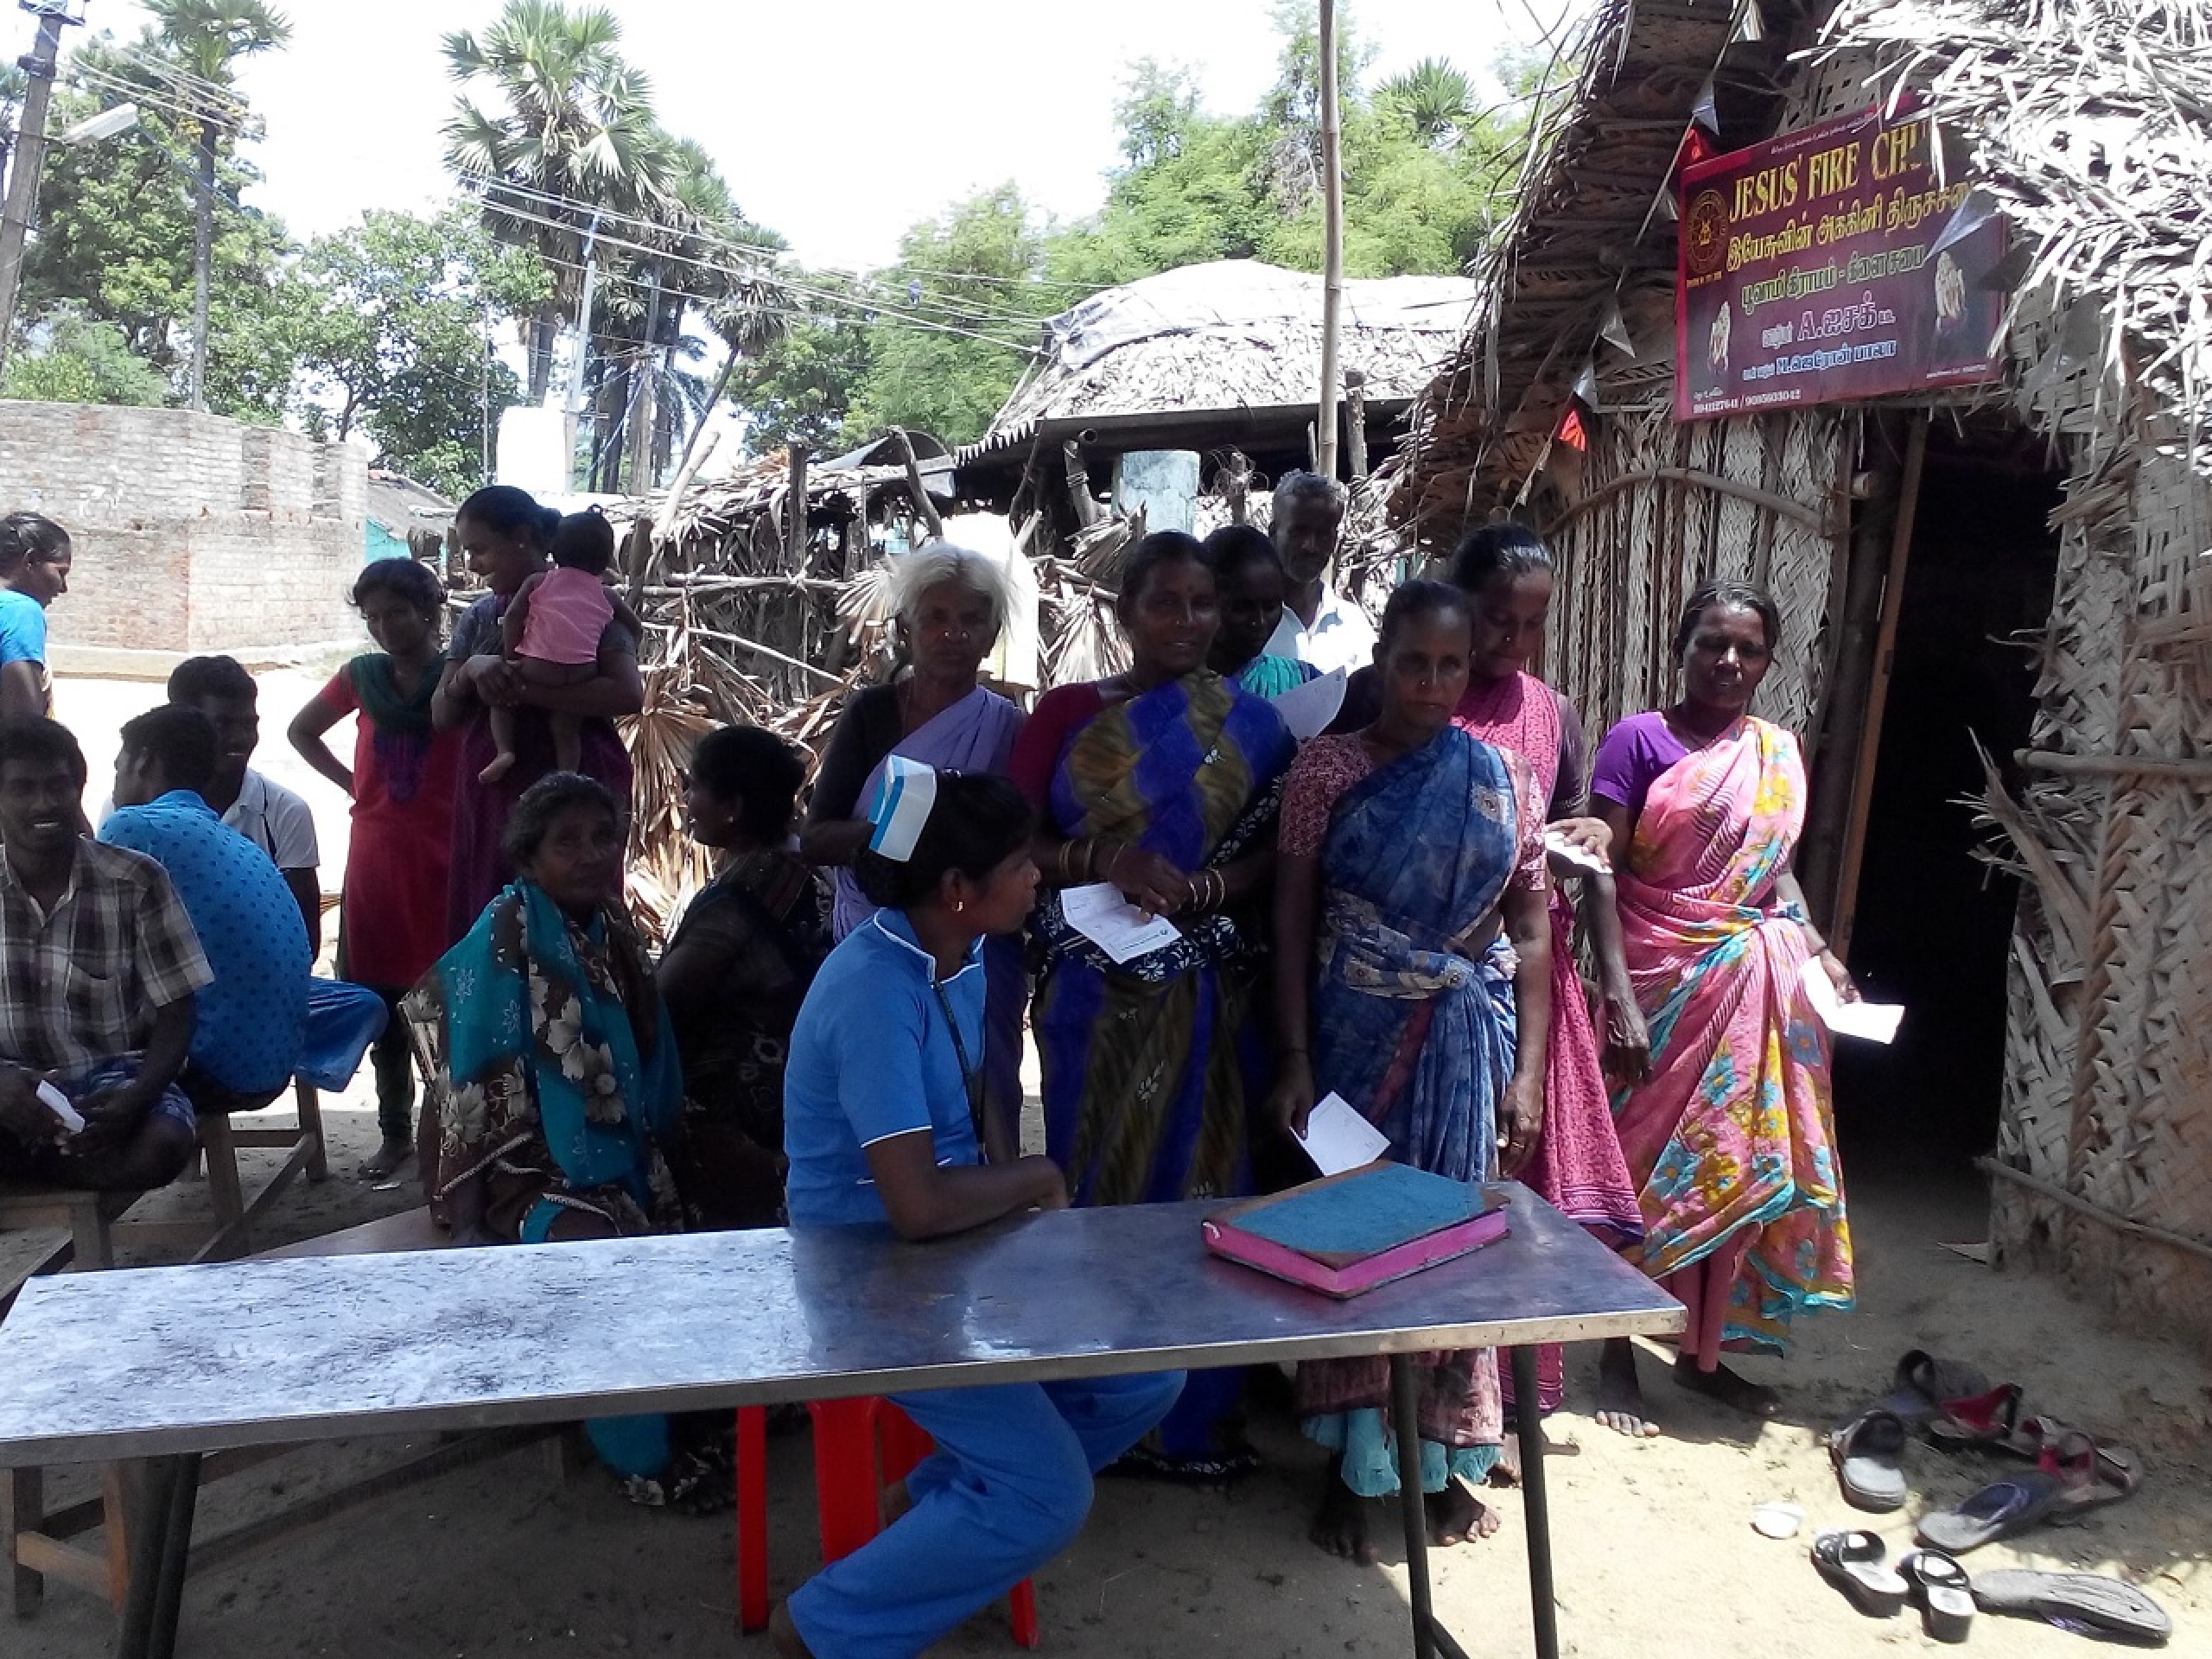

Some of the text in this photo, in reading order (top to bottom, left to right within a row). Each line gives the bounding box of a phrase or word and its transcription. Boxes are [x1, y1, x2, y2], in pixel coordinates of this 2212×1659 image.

[1808, 141, 1860, 201] FIRE
[1726, 210, 1814, 271] இயேசுவின்
[1816, 192, 1883, 245] அக்கினி
